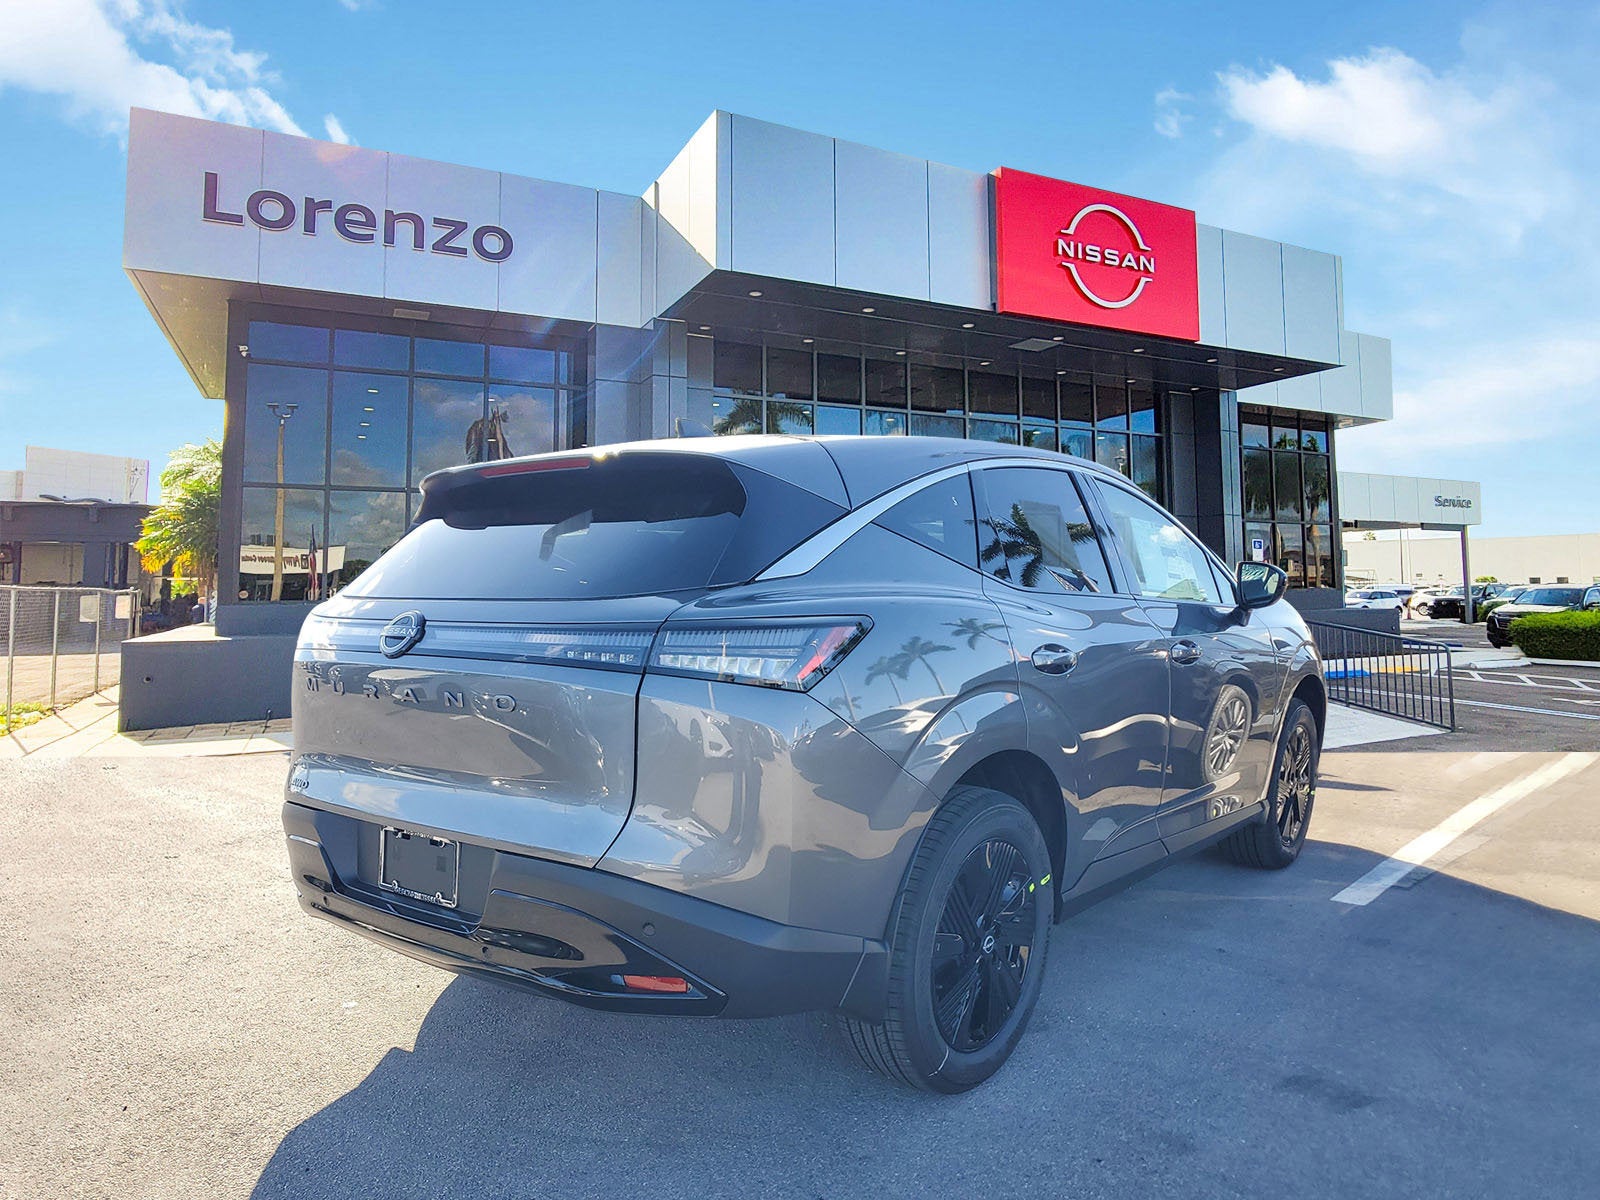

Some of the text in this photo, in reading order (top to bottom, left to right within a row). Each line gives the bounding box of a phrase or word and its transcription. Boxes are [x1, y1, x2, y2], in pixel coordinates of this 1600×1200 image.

[202, 171, 514, 262] Lorenzo
[1057, 238, 1155, 273] NISSAN
[1434, 495, 1472, 508] Service
[305, 677, 517, 712] MURANO
